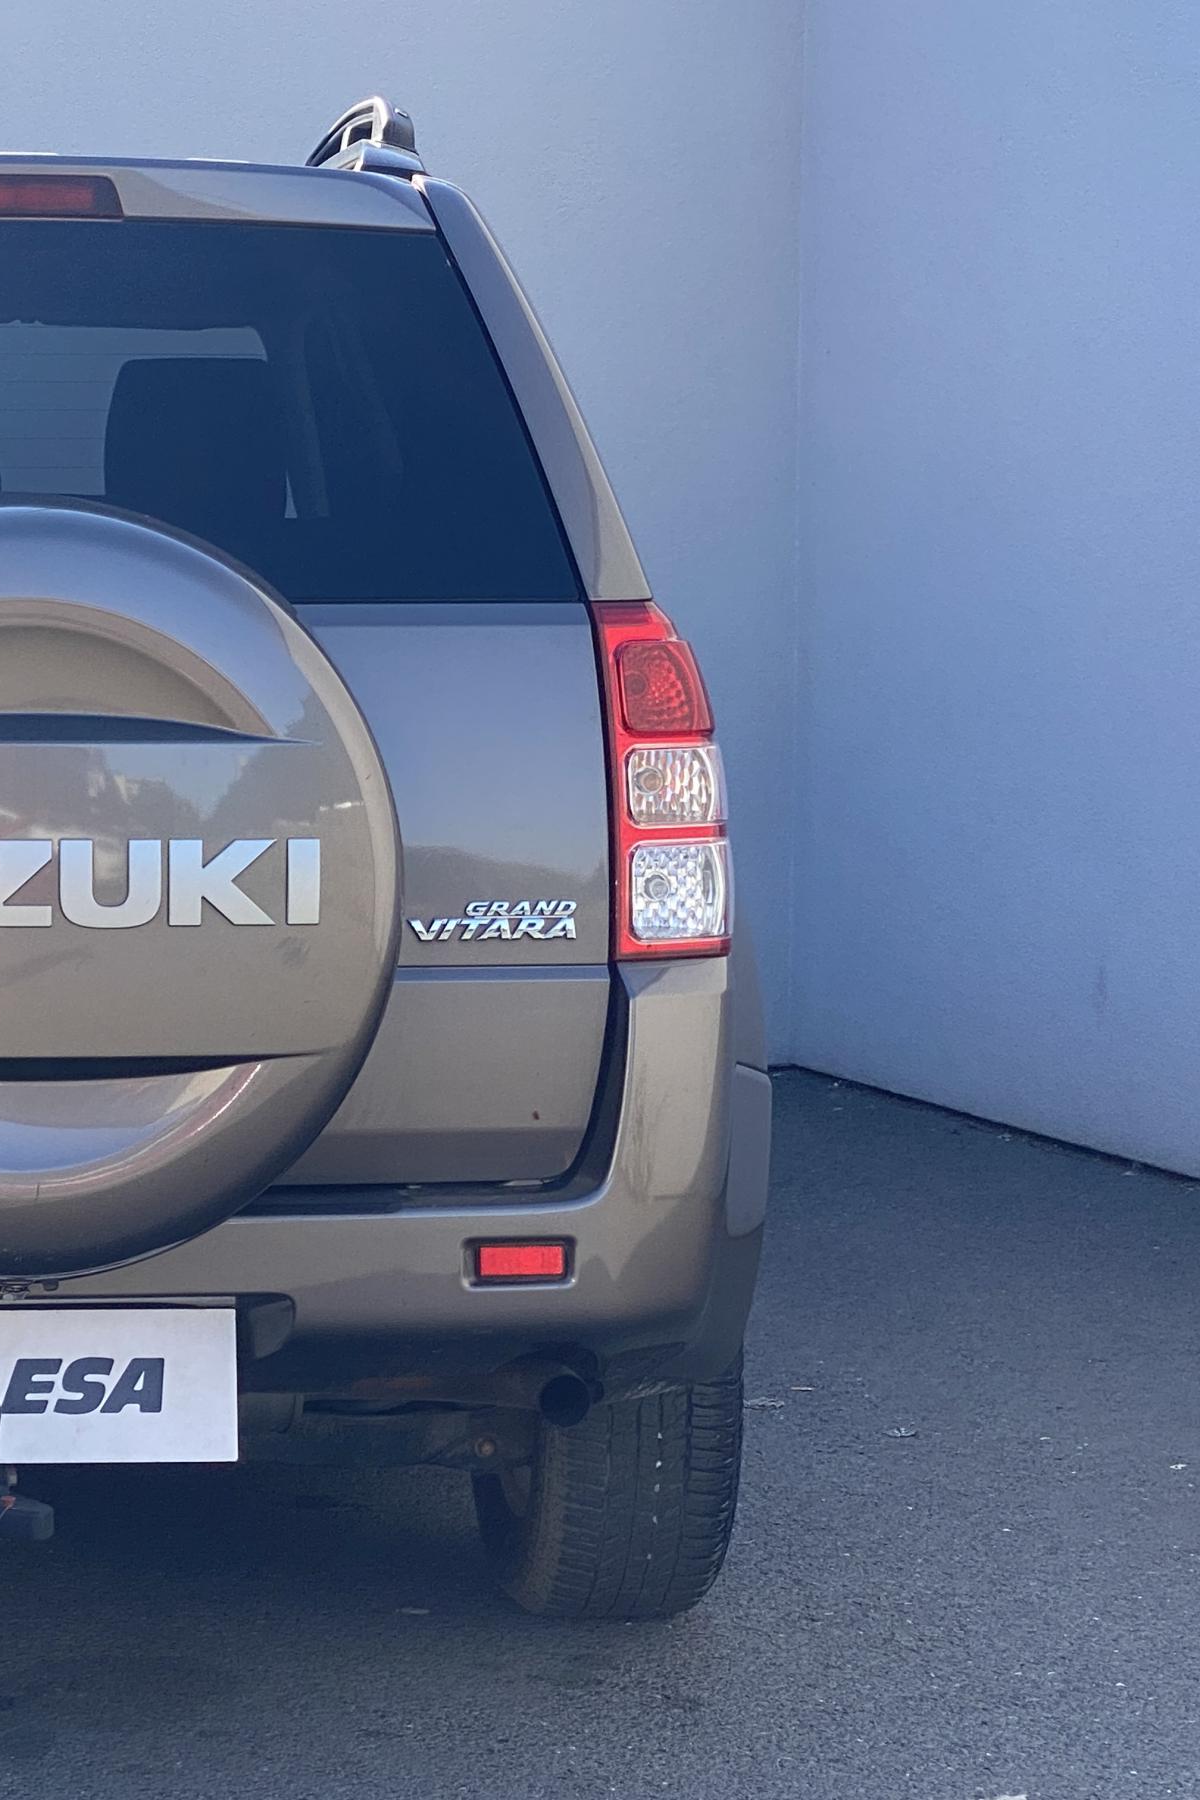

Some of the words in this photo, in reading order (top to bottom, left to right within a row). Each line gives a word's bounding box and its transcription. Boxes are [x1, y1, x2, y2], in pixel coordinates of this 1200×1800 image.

[465, 900, 577, 917] GRAND
[406, 916, 577, 942] VITARA
[1, 1357, 165, 1414] ESA
